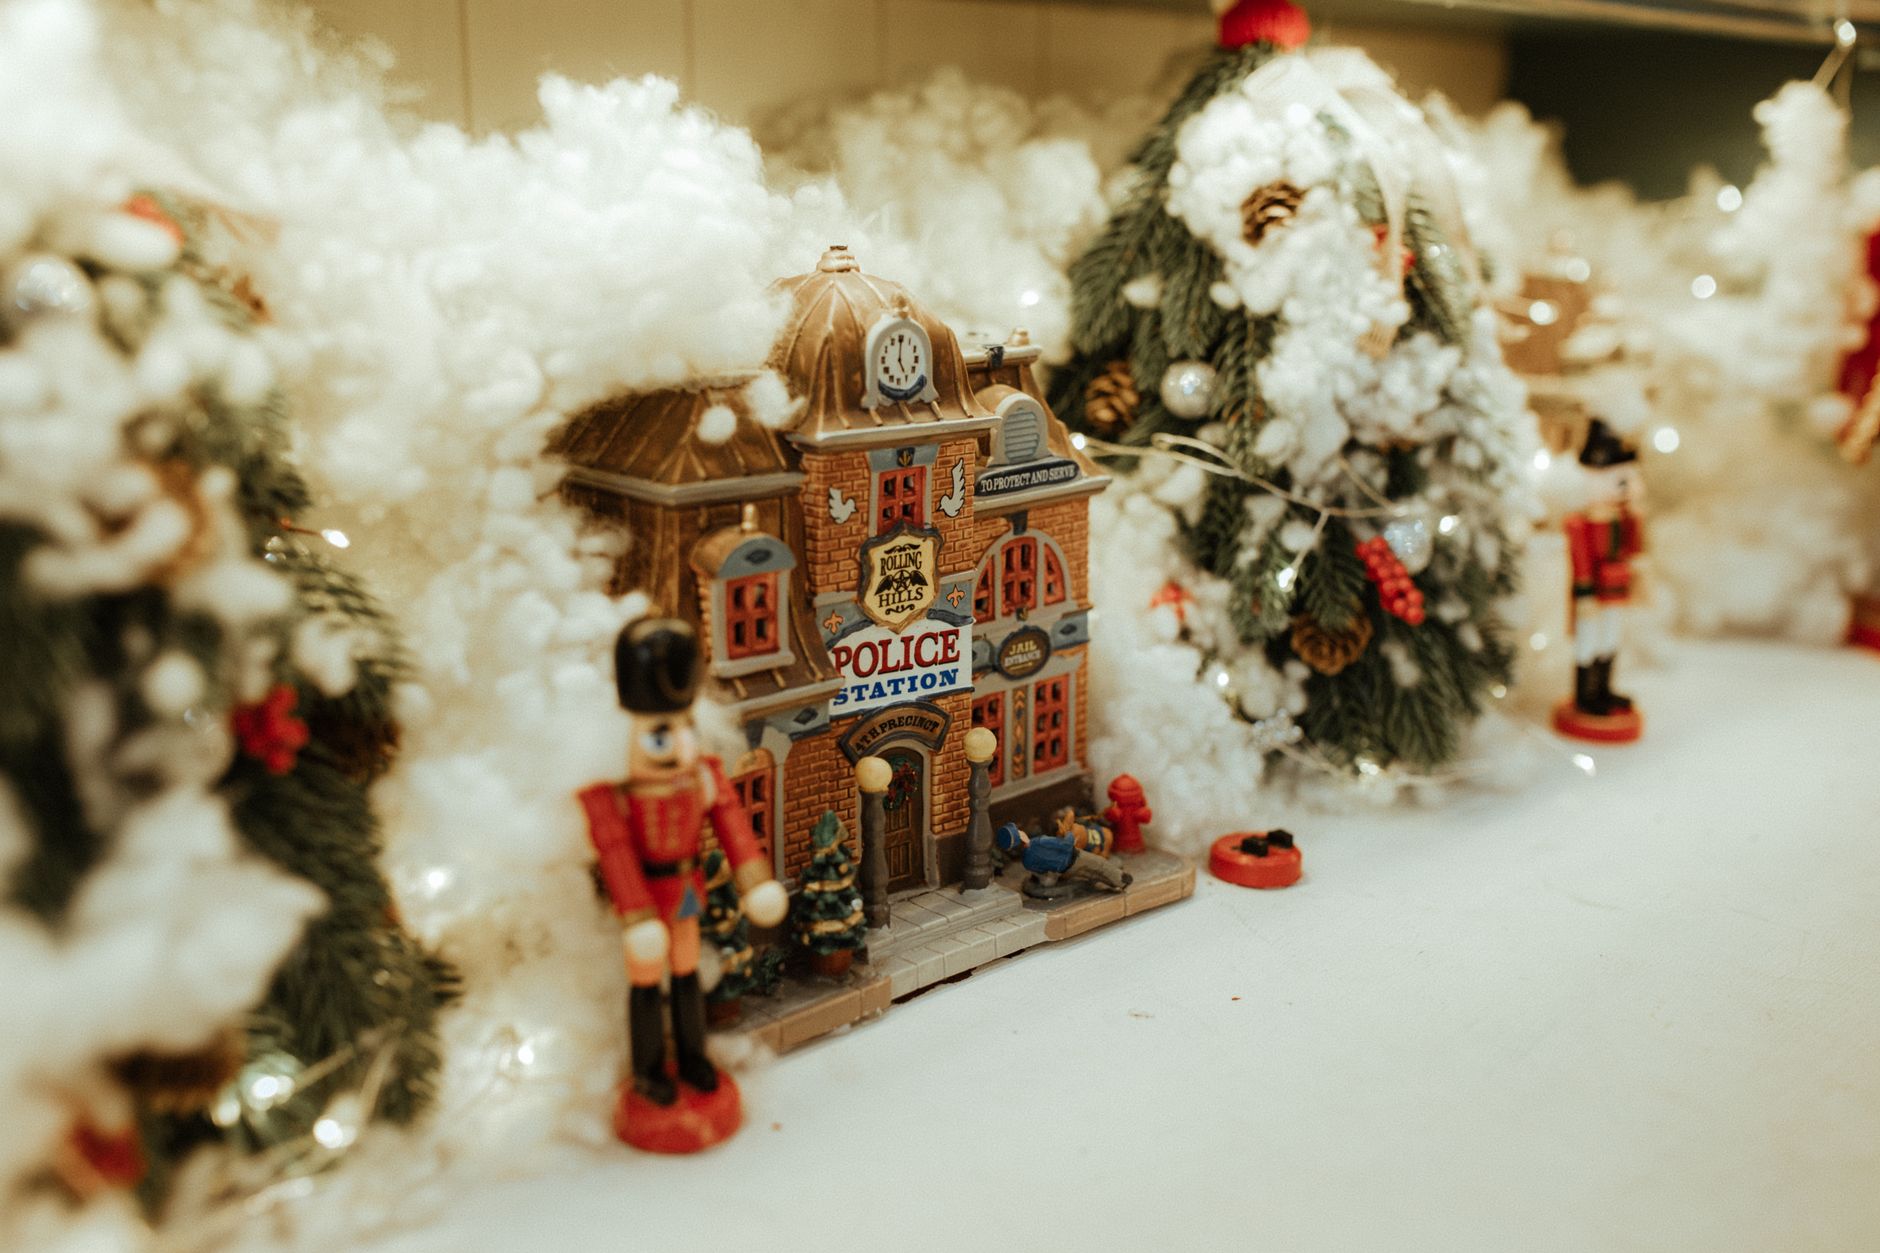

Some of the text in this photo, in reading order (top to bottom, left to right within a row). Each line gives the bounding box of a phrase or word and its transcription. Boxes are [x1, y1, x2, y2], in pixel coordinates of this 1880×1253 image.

[981, 464, 1076, 492] TO PROTECT AND SERVE
[880, 551, 922, 576] ROLLING
[878, 586, 924, 608] HILLS
[831, 628, 960, 678] POLICE
[1009, 640, 1037, 655] JAIL
[832, 668, 959, 706] STATION
[878, 715, 940, 734] PRECINCT
